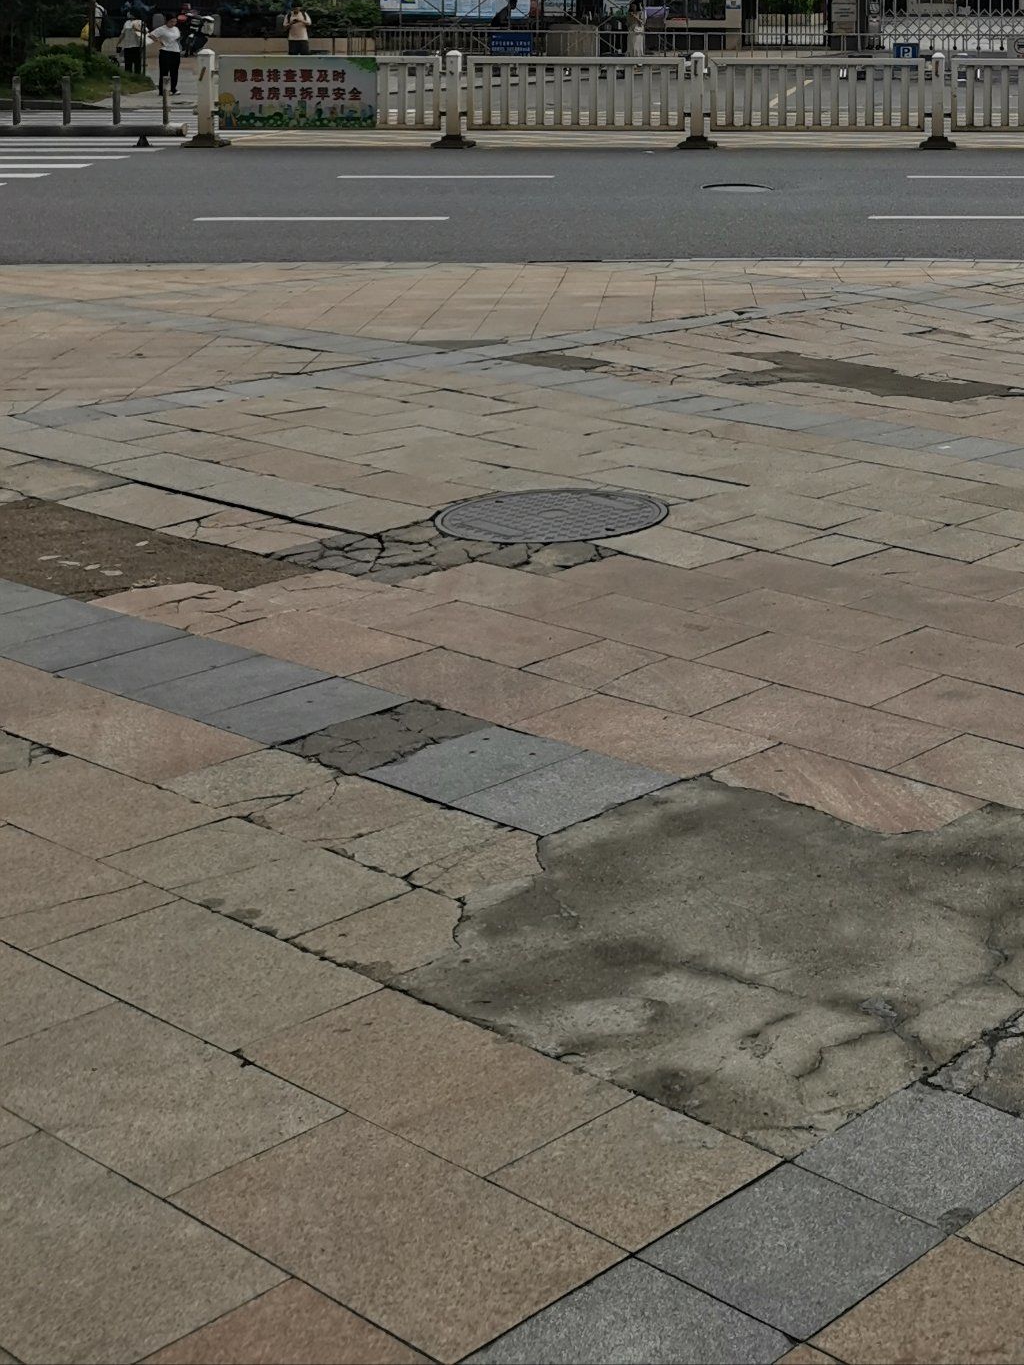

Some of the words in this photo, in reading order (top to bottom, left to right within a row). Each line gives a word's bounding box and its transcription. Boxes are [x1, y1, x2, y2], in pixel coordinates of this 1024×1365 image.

[233, 68, 347, 83] 隐患排查要及时
[250, 87, 363, 101] 危房早拆早安全
